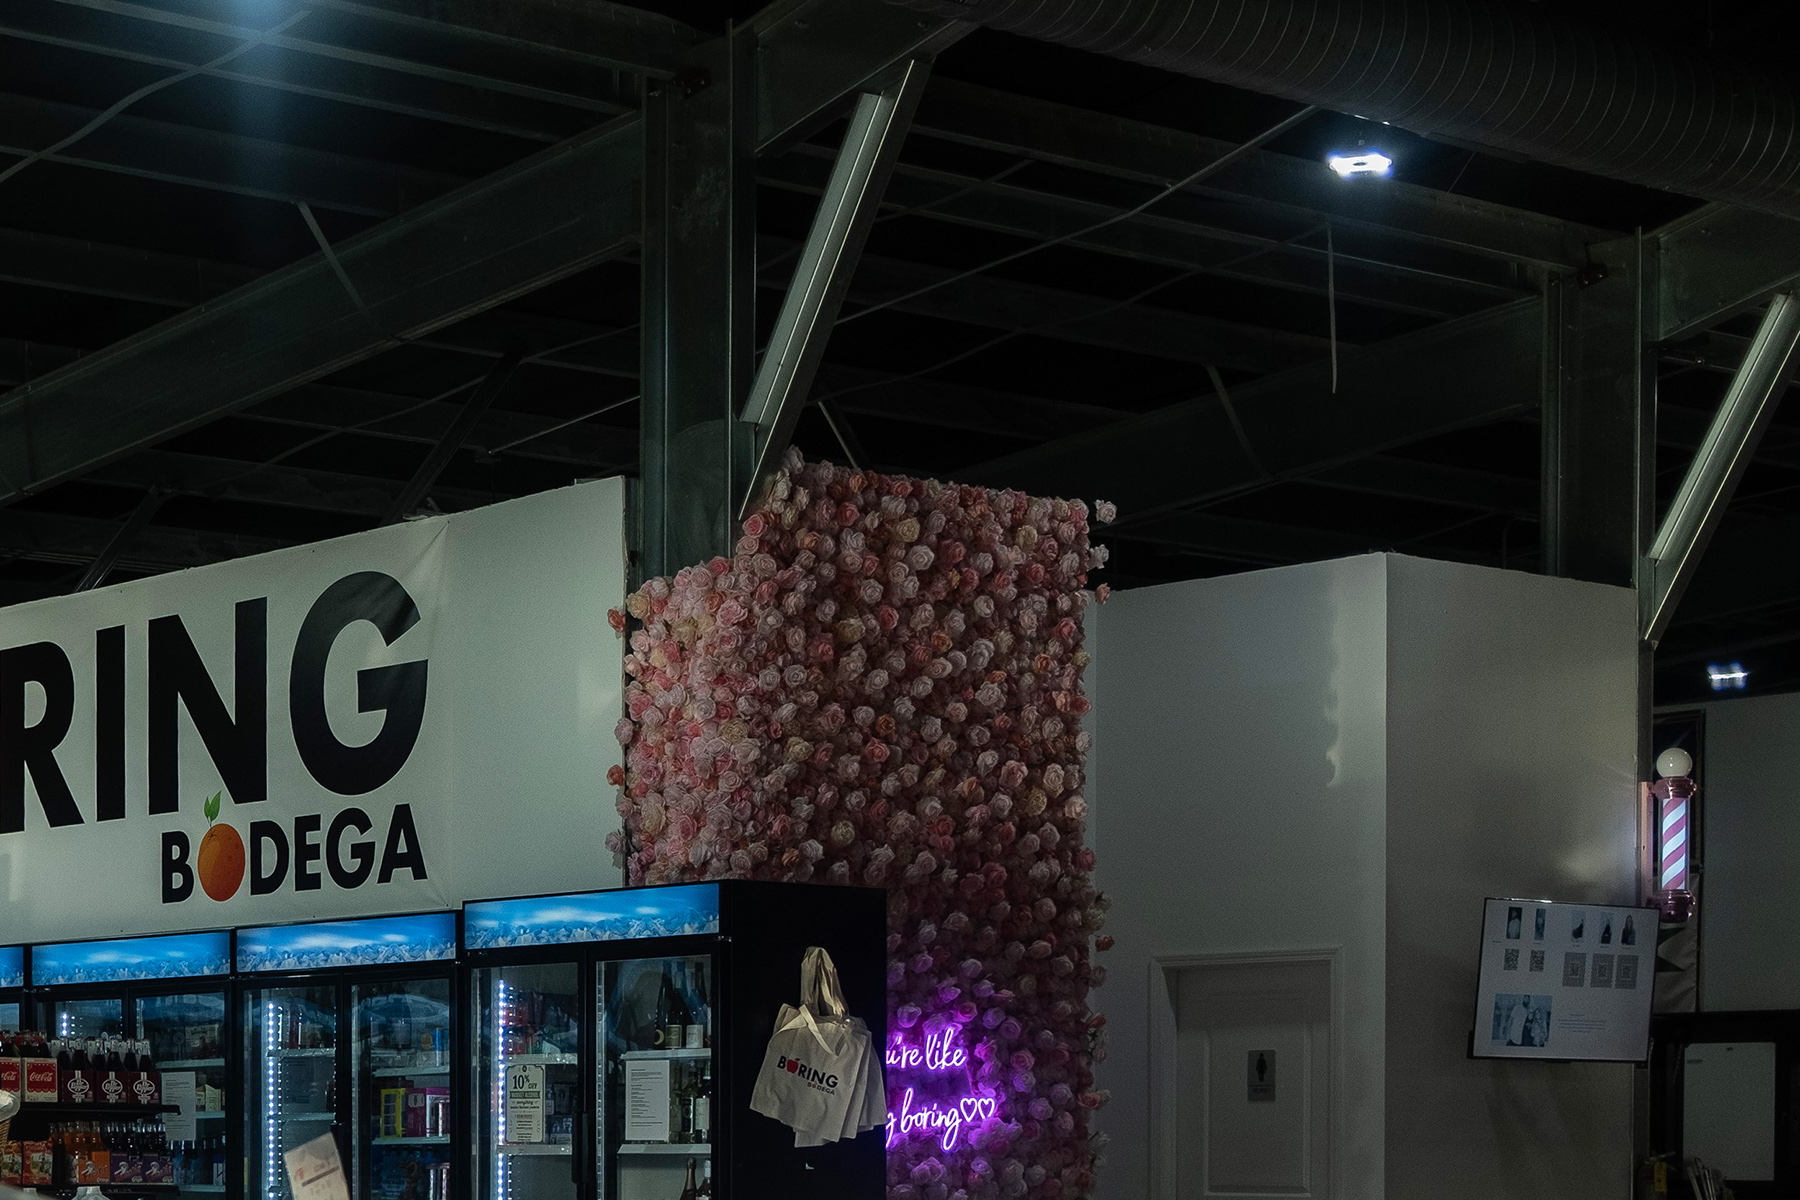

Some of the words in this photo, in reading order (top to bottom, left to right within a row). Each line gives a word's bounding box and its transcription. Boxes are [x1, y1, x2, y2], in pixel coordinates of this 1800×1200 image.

[161, 803, 427, 904] BODEGA
[926, 1027, 967, 1070] like
[29, 1071, 54, 1082] Coca-Cola
[777, 1055, 839, 1088] BORING
[807, 1082, 835, 1096] BODEGA
[901, 1087, 962, 1151] boring
